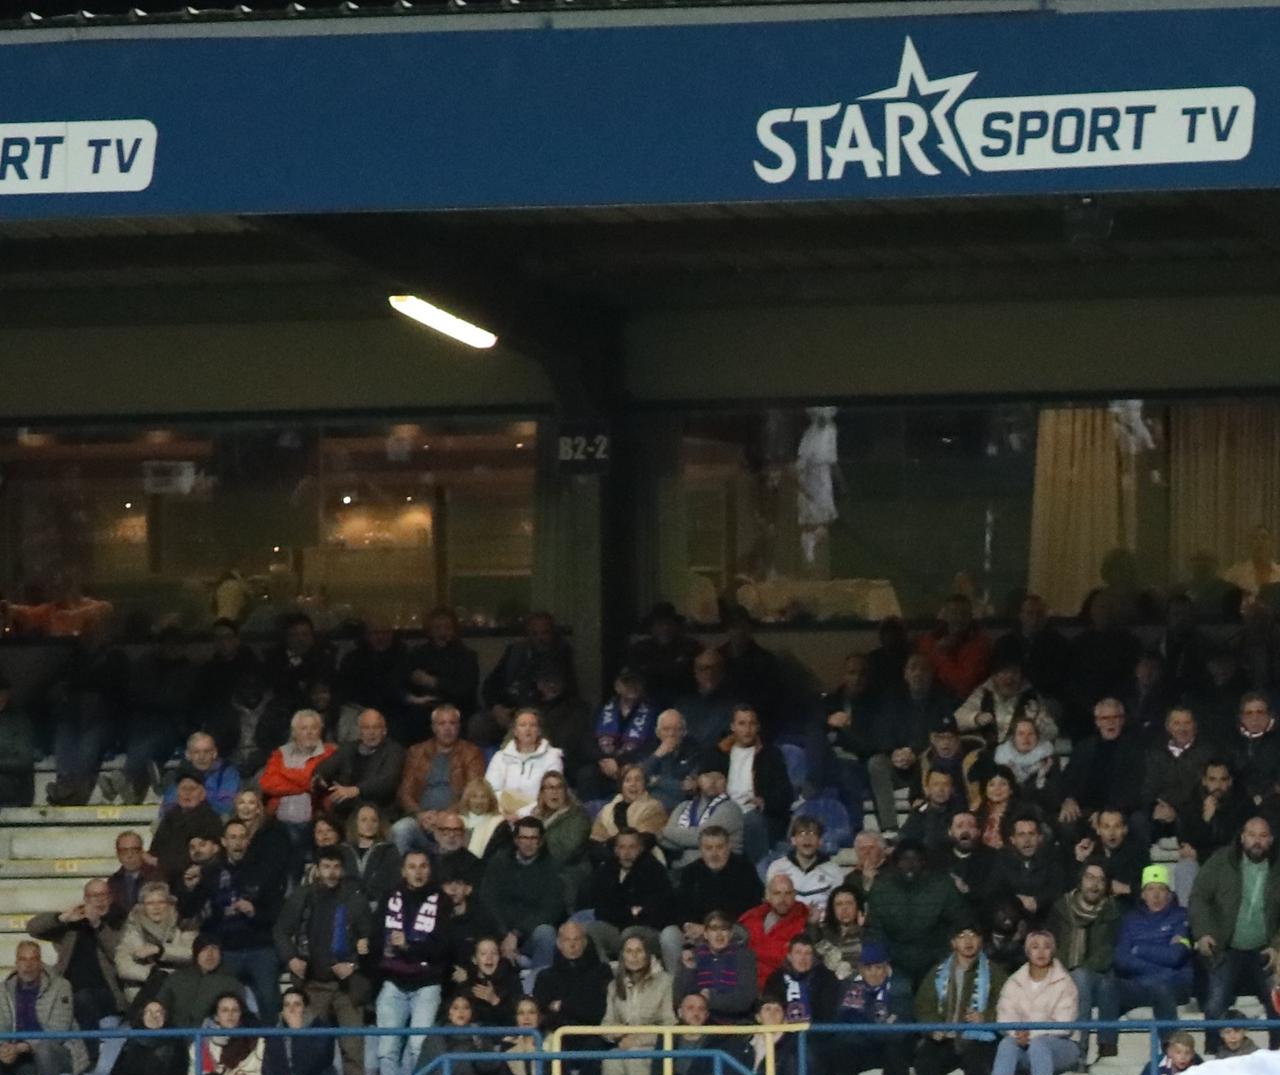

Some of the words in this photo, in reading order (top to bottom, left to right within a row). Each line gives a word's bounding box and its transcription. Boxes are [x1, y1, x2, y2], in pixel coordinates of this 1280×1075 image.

[88, 138, 142, 174] TV
[753, 102, 942, 183] STAR
[980, 105, 1156, 157] SPORT
[1182, 105, 1240, 143] TV
[558, 435, 608, 461] B2-2
